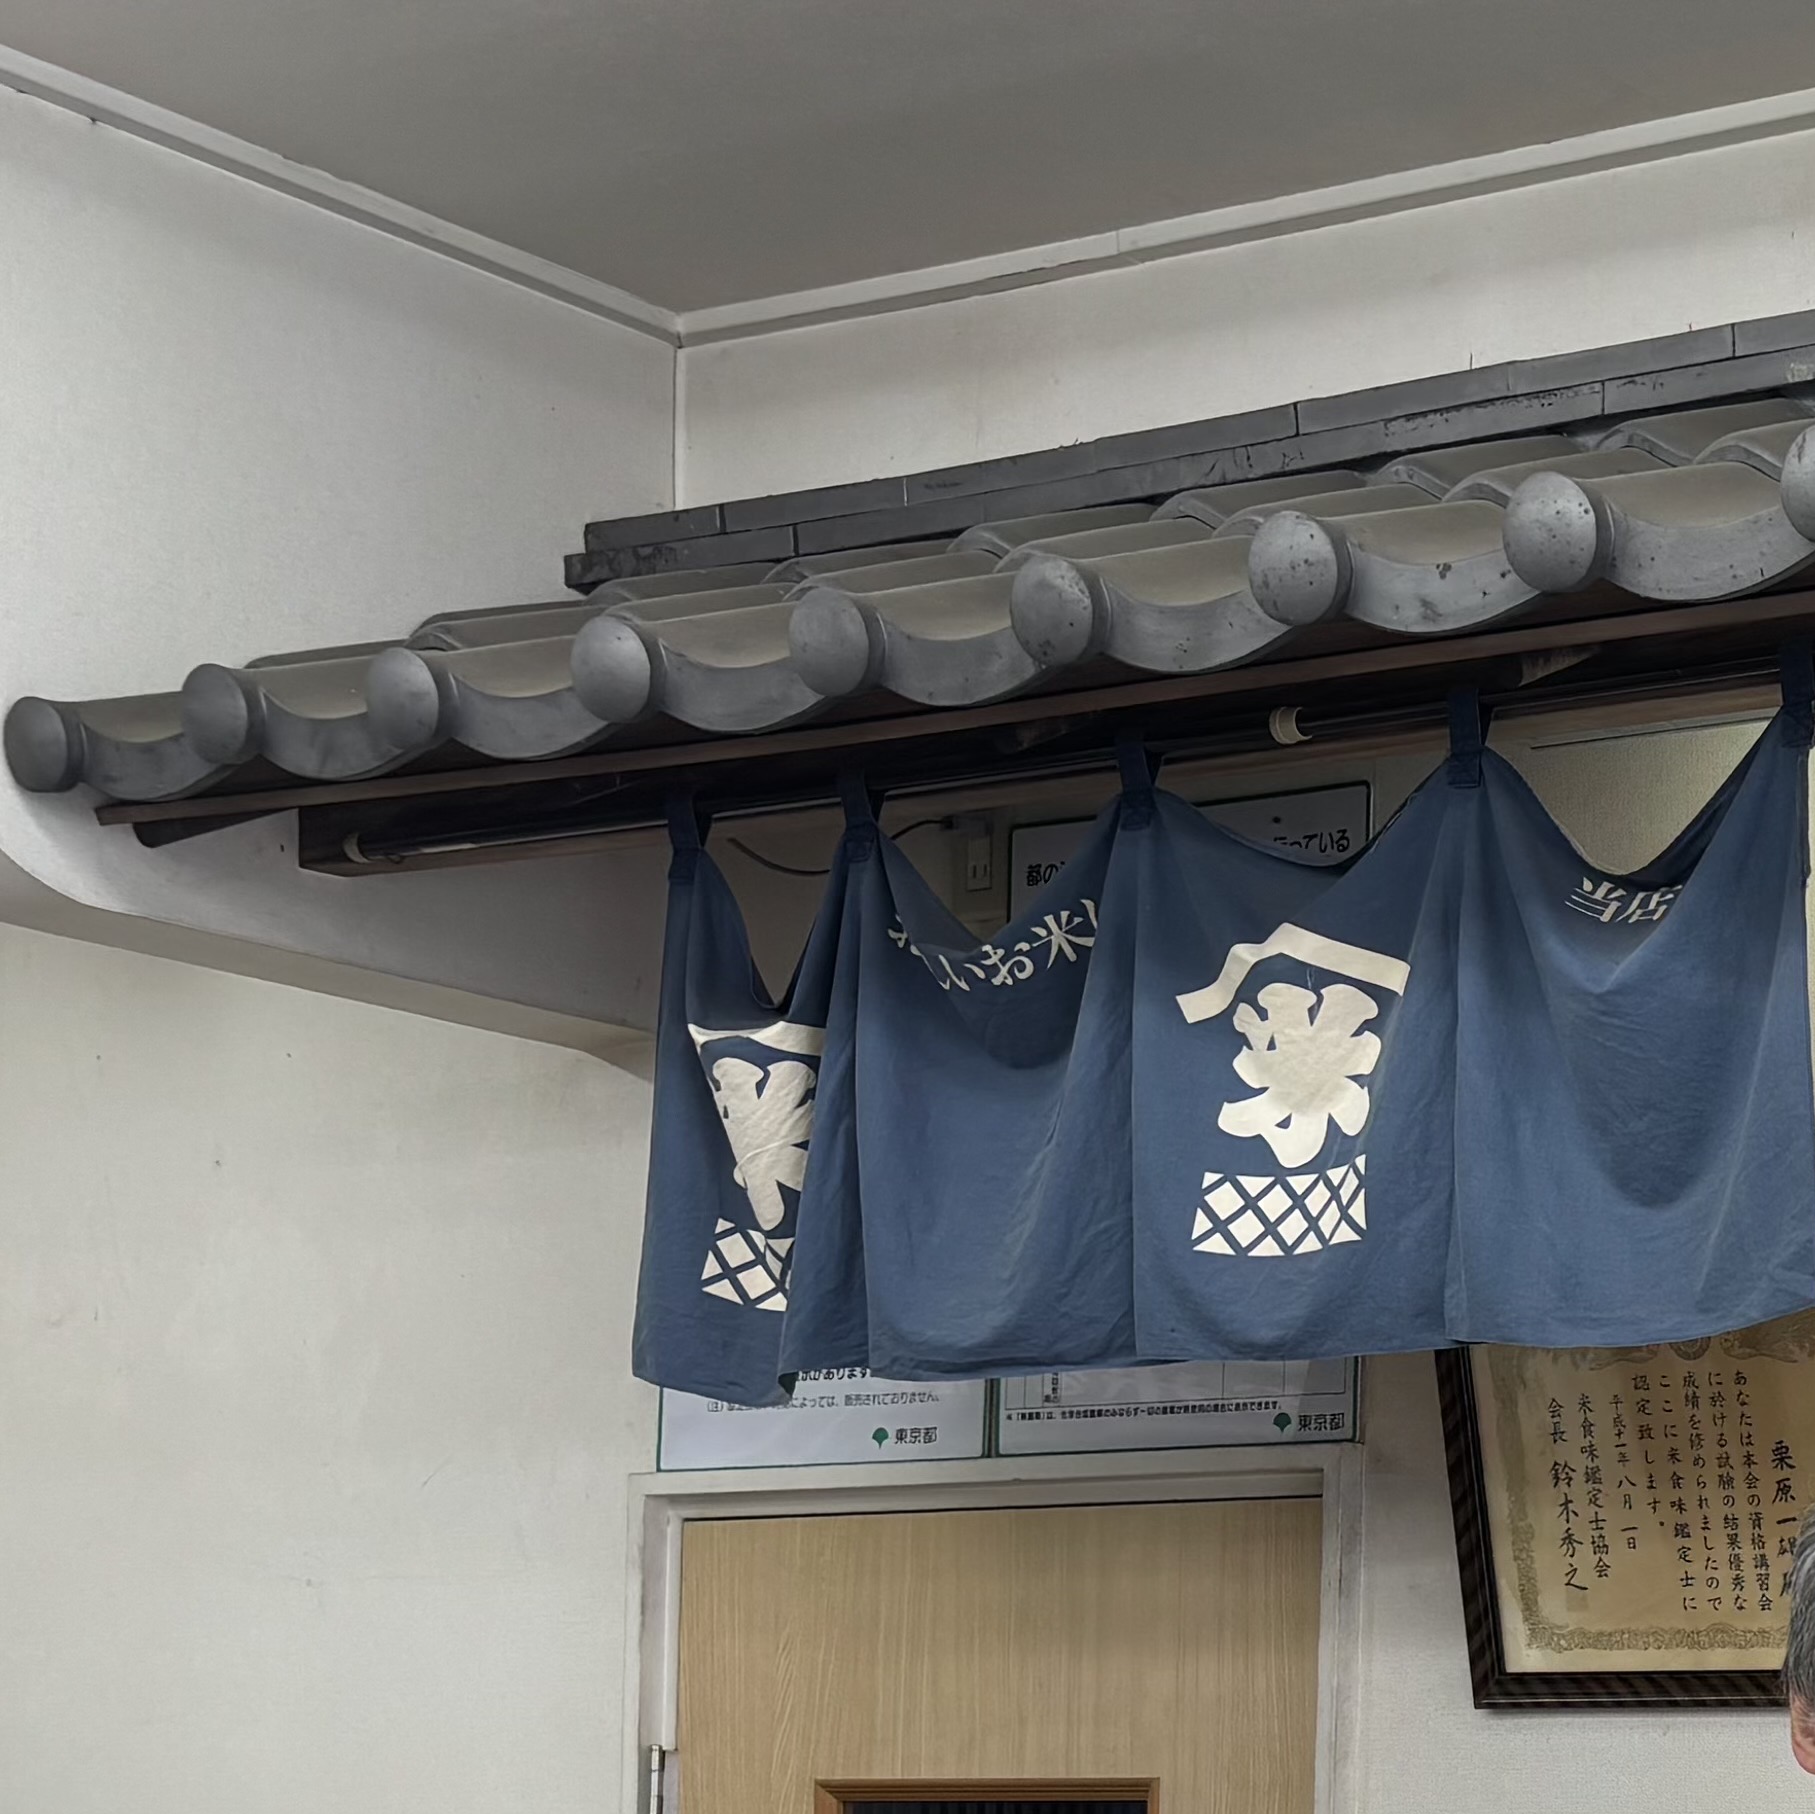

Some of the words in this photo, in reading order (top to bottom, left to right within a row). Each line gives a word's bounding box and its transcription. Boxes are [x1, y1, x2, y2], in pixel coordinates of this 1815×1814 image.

[1297, 1412, 1346, 1433] 東京都
[894, 1426, 938, 1445] 東京都
